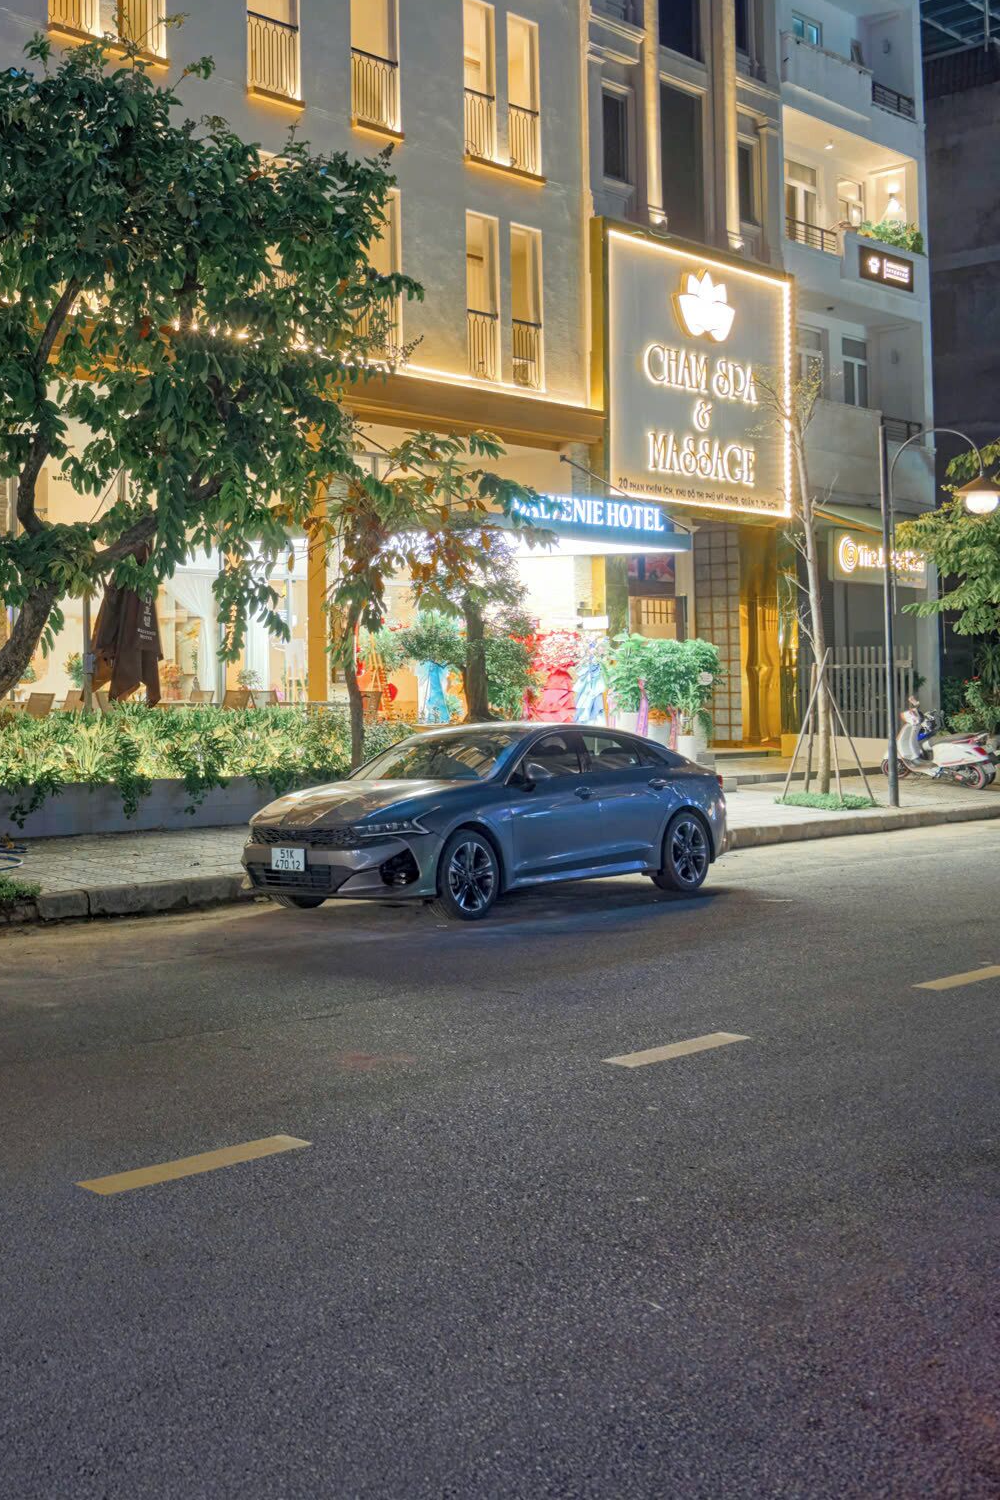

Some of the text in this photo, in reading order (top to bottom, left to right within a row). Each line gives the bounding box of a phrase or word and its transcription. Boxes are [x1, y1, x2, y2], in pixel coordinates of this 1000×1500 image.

[643, 343, 758, 404] CHAM SPA
[693, 399, 713, 432] &
[646, 430, 756, 487] MASSAGE
[618, 477, 628, 489] 20
[606, 501, 664, 532] HOTEL
[275, 859, 301, 870] 470.12
[280, 849, 294, 859] 51K
